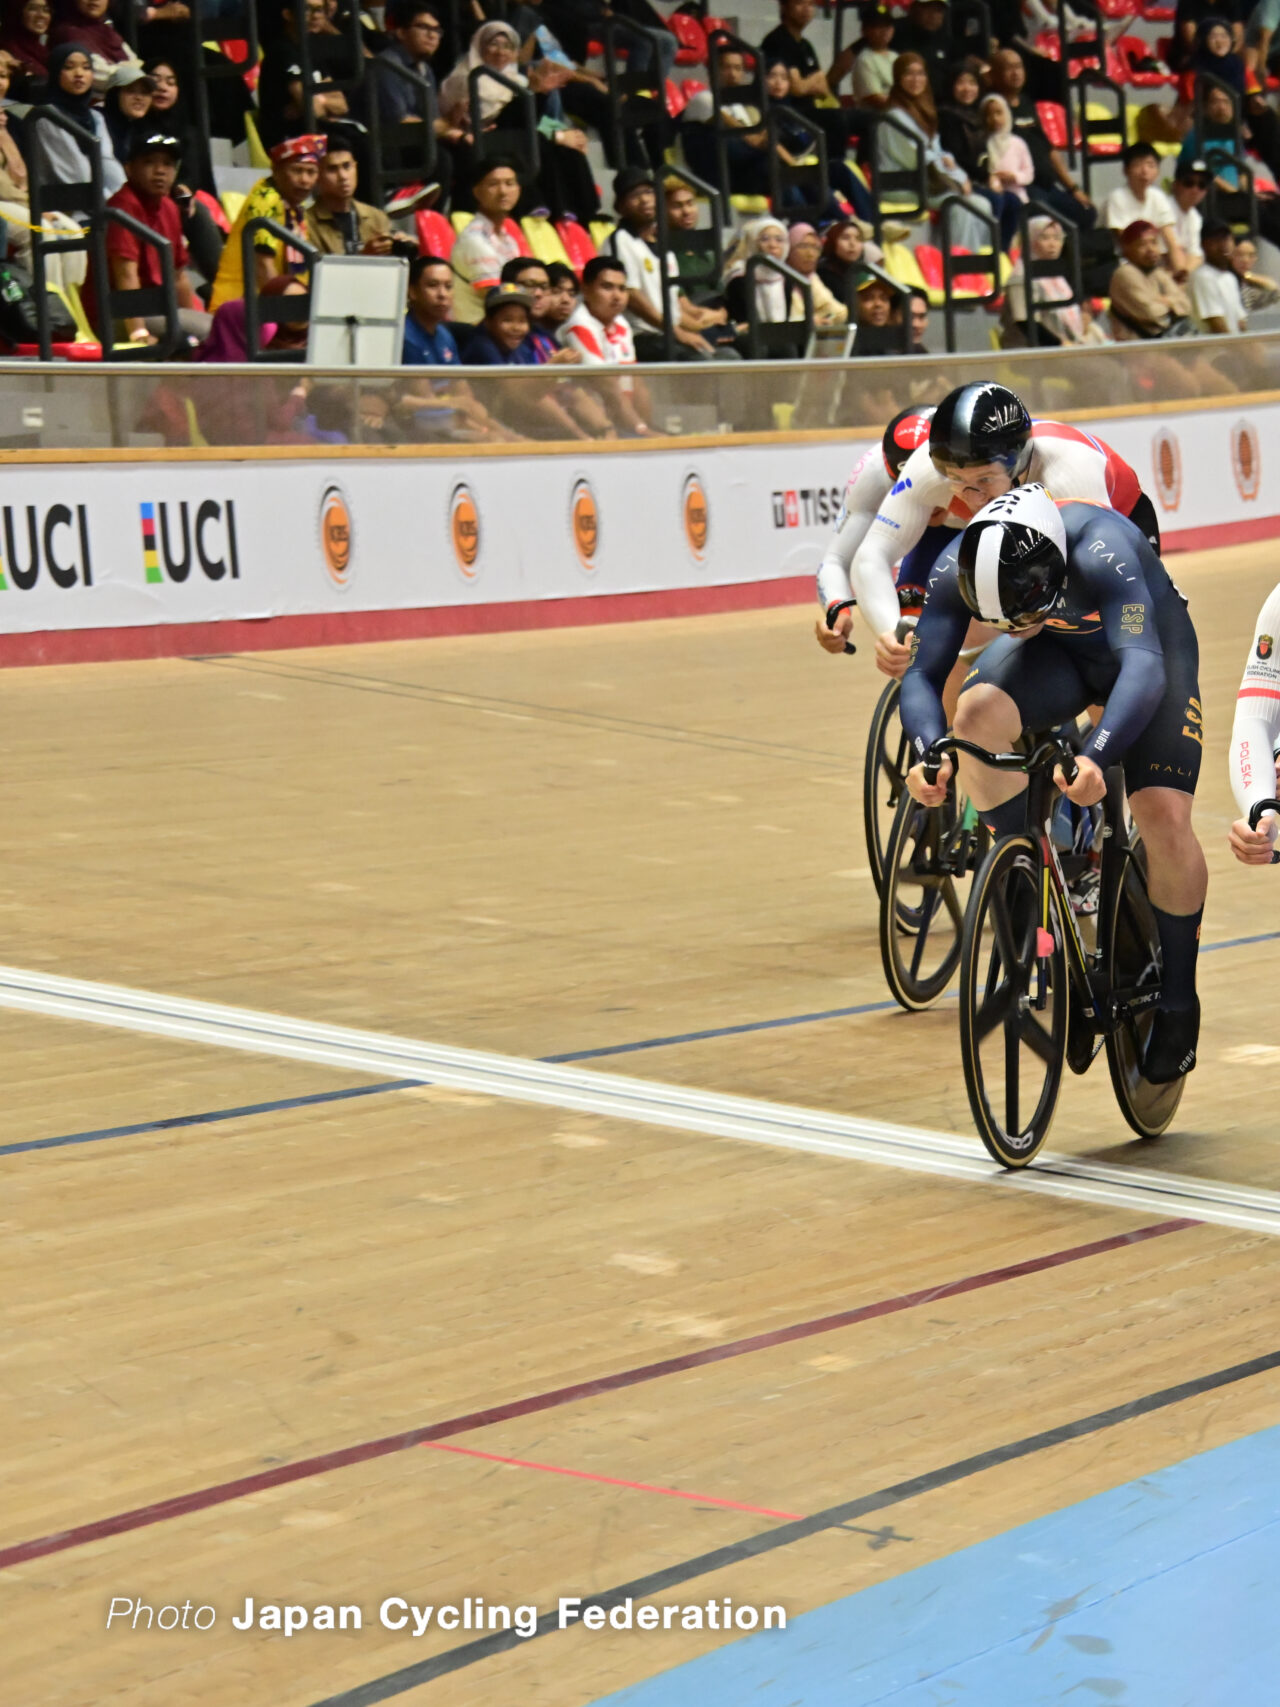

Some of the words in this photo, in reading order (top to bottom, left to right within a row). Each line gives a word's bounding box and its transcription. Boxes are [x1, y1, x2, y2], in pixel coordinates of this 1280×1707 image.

[3, 503, 93, 590] UCI
[158, 499, 240, 583] UCI
[1088, 540, 1136, 581] RALI
[1120, 603, 1144, 634] ESP
[1240, 741, 1253, 789] POLSKA
